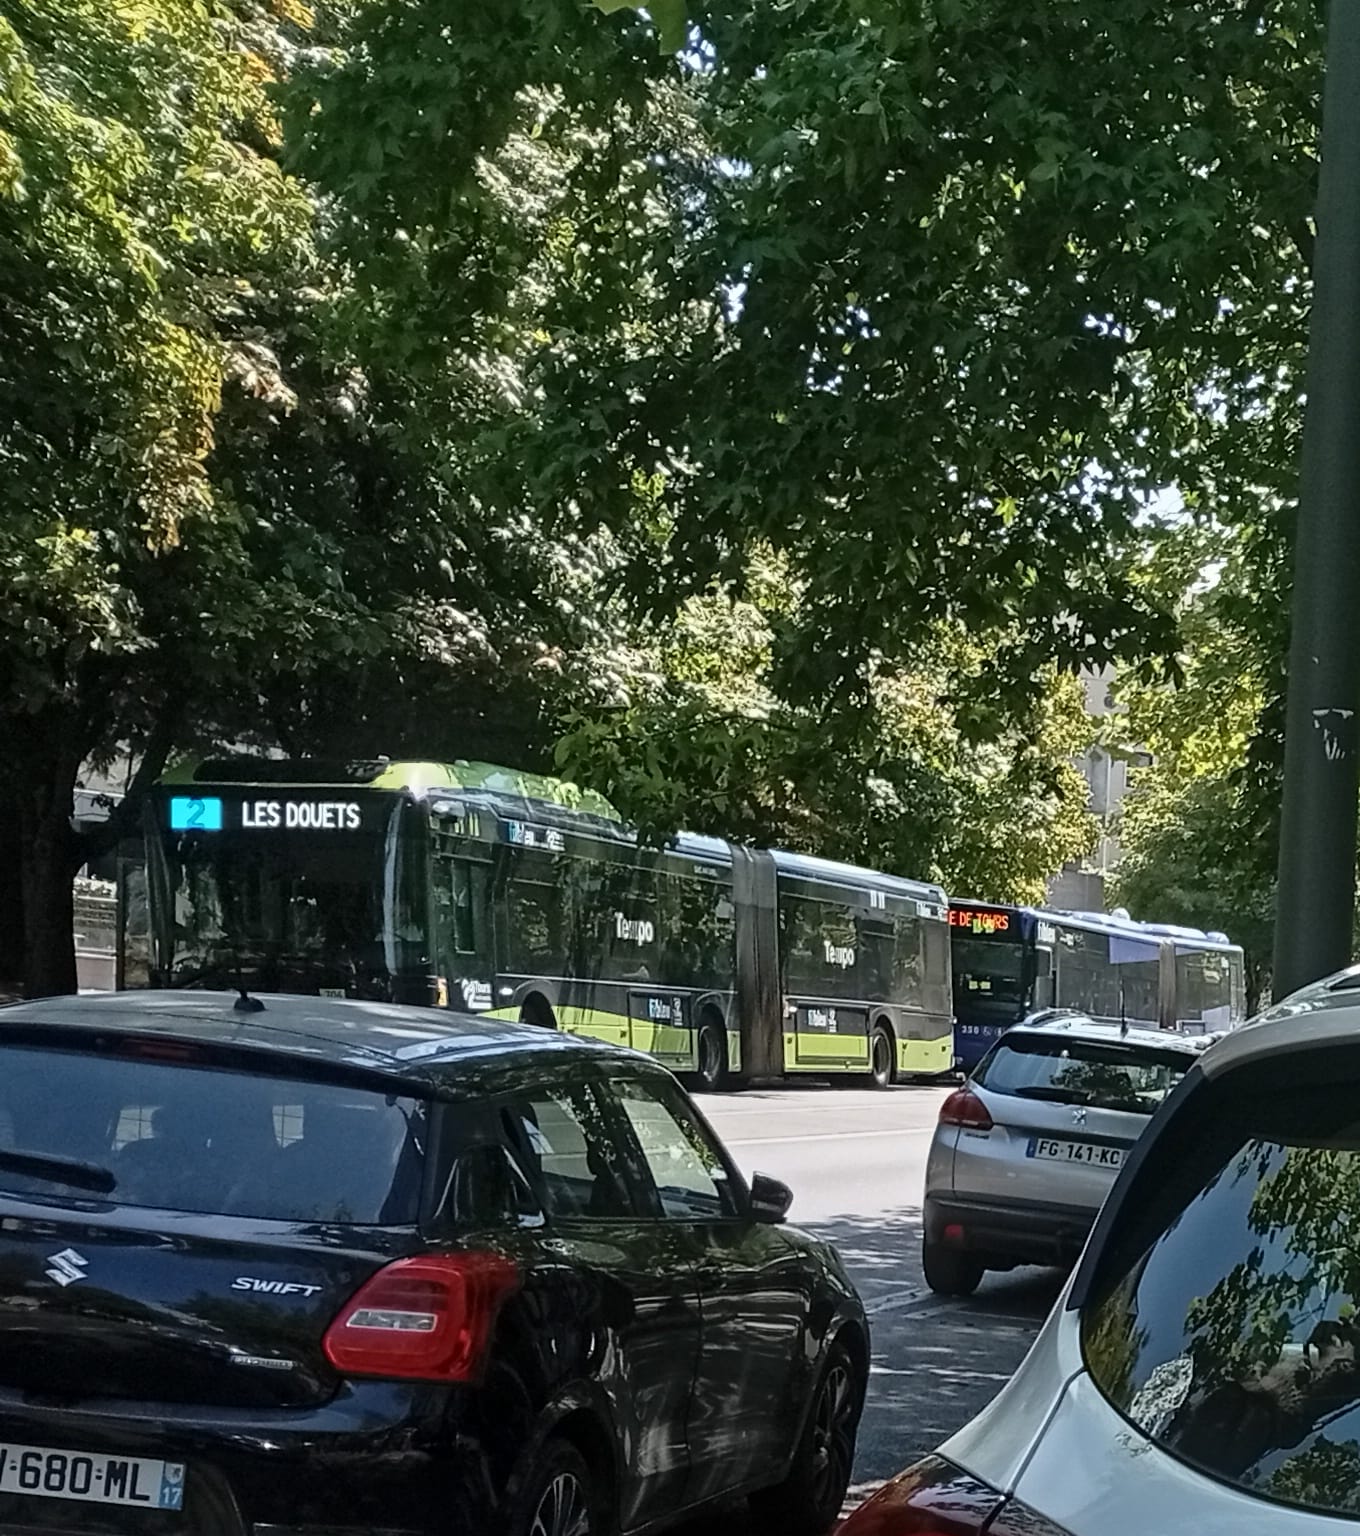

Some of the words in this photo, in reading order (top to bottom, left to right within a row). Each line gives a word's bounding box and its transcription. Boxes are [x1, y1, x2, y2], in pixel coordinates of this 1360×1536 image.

[186, 799, 206, 827] 2
[242, 801, 281, 828] LES
[286, 802, 361, 829] DOUETS
[614, 911, 654, 946] Tempo
[960, 912, 972, 926] DE
[976, 913, 1009, 929] TOURS
[824, 940, 855, 970] Tempo
[1038, 1139, 1121, 1165] FG-141-KC
[231, 1277, 322, 1297] SWIFT
[163, 1486, 182, 1505] 17
